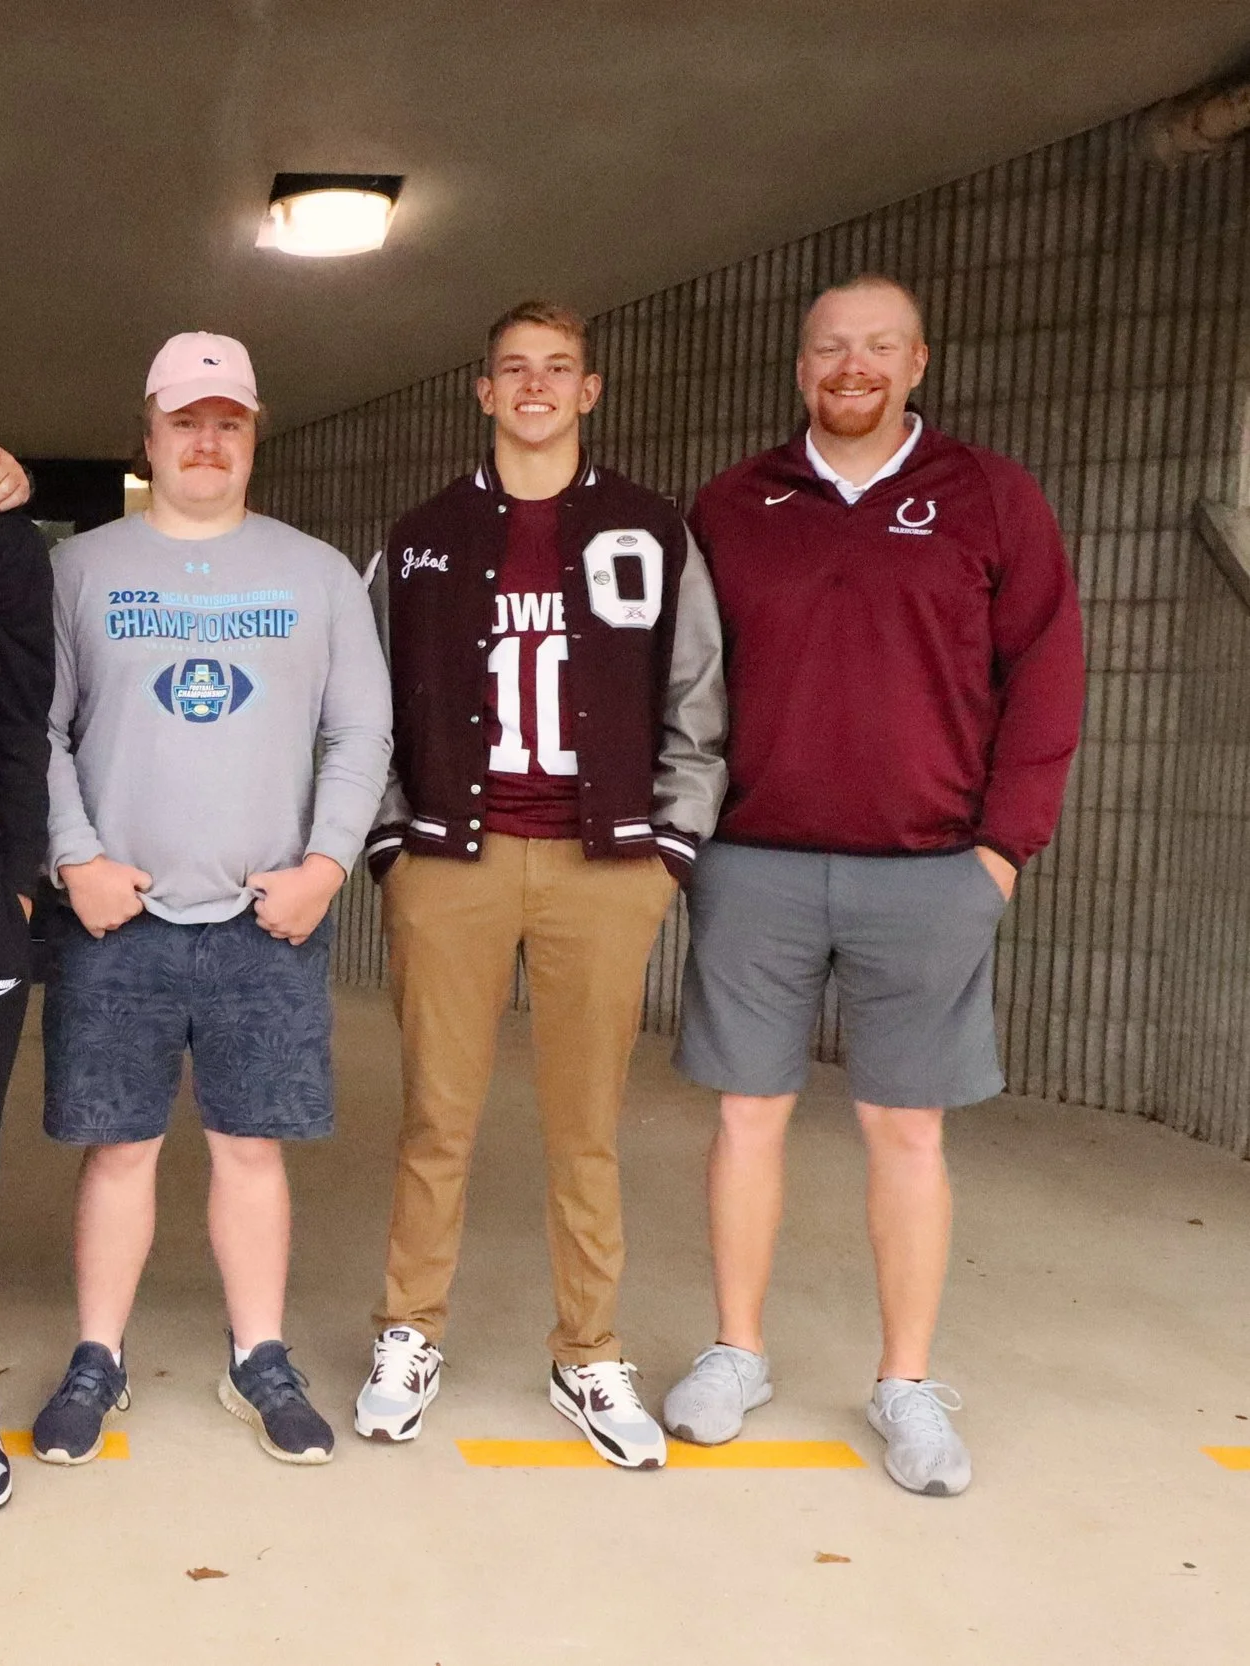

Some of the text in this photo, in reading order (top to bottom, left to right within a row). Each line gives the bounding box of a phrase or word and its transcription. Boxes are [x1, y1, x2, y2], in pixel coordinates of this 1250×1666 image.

[108, 590, 160, 604] 2022
[193, 592, 239, 605] DIVISION
[492, 592, 566, 634] OWE
[105, 608, 299, 643] CHAMPIONSHIP
